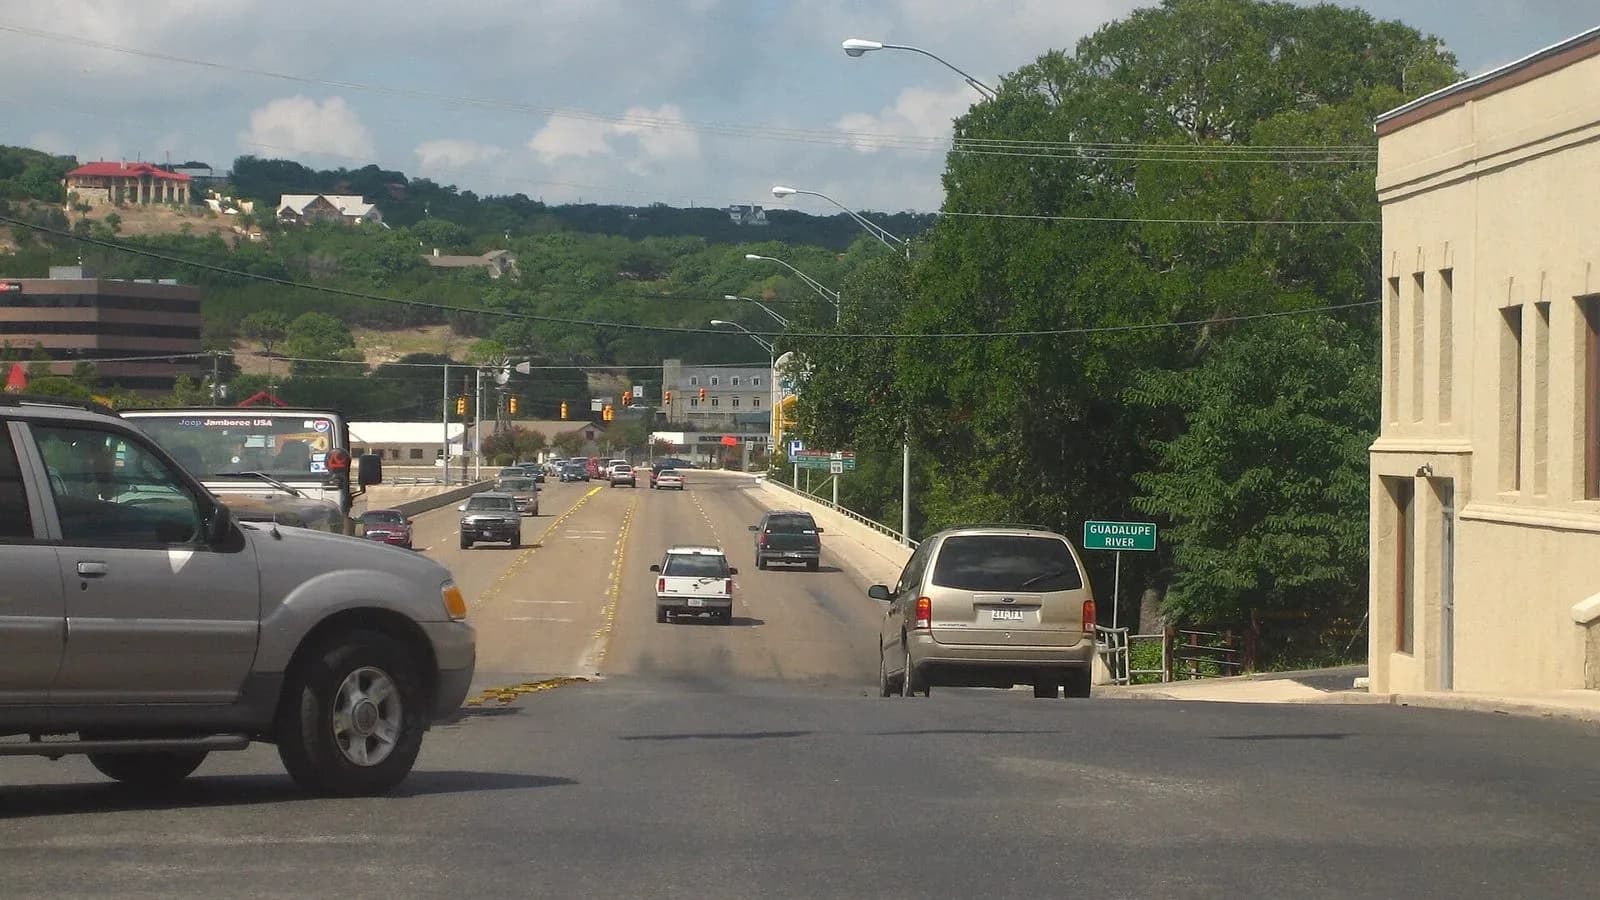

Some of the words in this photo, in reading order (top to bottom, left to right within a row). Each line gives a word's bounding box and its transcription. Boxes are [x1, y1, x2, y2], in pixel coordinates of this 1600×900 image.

[178, 419, 202, 427] Jeep
[1090, 524, 1151, 536] GUADALUPE
[1105, 537, 1134, 547] RIVER
